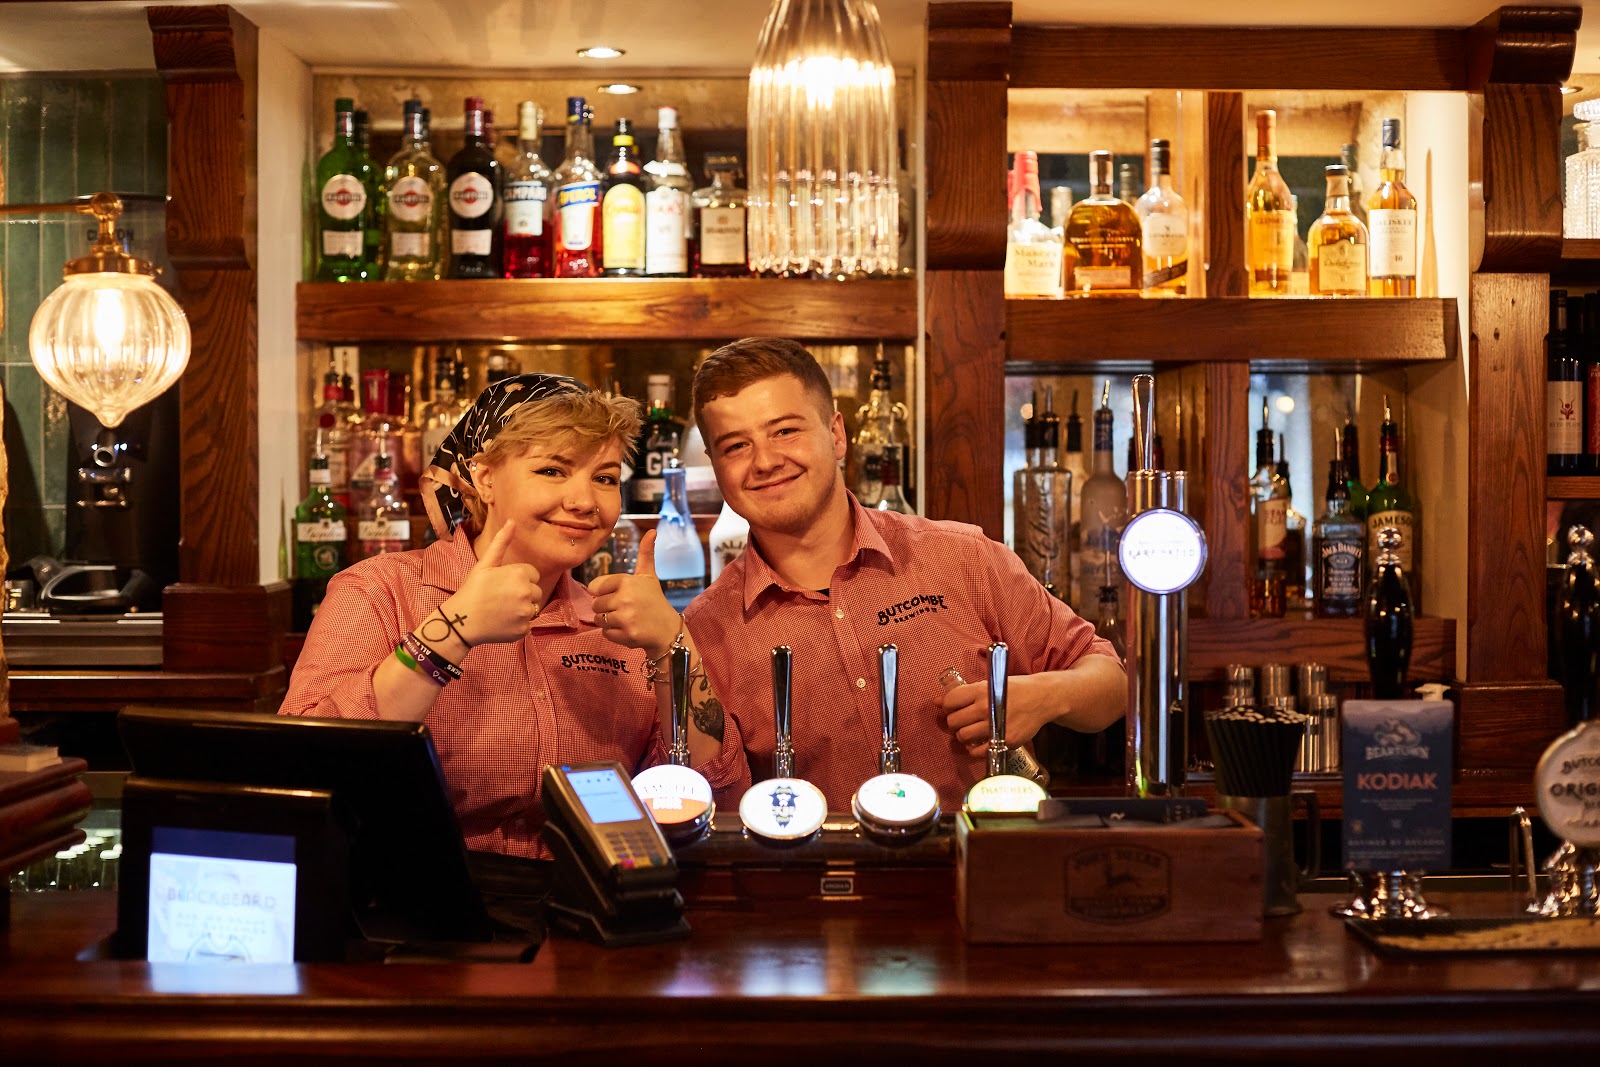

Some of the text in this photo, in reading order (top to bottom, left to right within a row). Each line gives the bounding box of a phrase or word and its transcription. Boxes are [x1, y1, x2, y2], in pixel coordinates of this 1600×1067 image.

[877, 594, 948, 626] BUTCOMBE
[561, 653, 630, 674] BUTCOMBE
[1356, 772, 1439, 791] KODIAK
